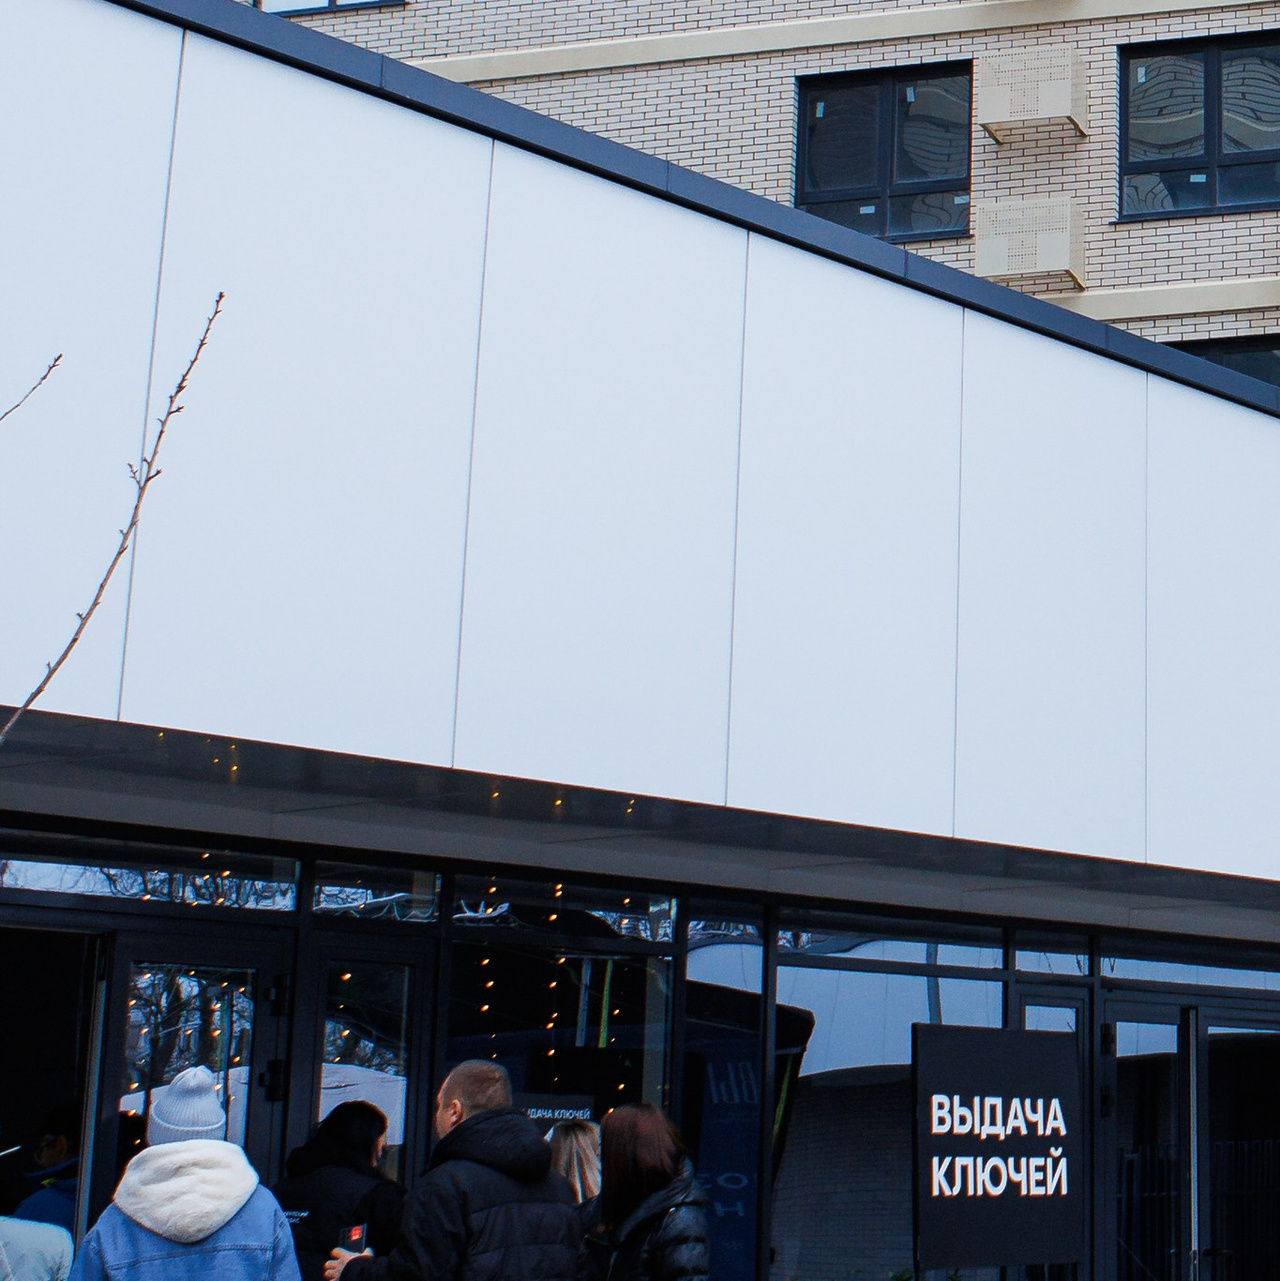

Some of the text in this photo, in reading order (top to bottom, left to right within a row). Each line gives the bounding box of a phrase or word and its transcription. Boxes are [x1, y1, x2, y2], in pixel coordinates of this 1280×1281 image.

[554, 1107, 592, 1120] КЛЮЧЕЙ
[931, 1093, 1068, 1141] ВЫДАЧА
[932, 1146, 1069, 1198] КЛЮЧЕЙ
